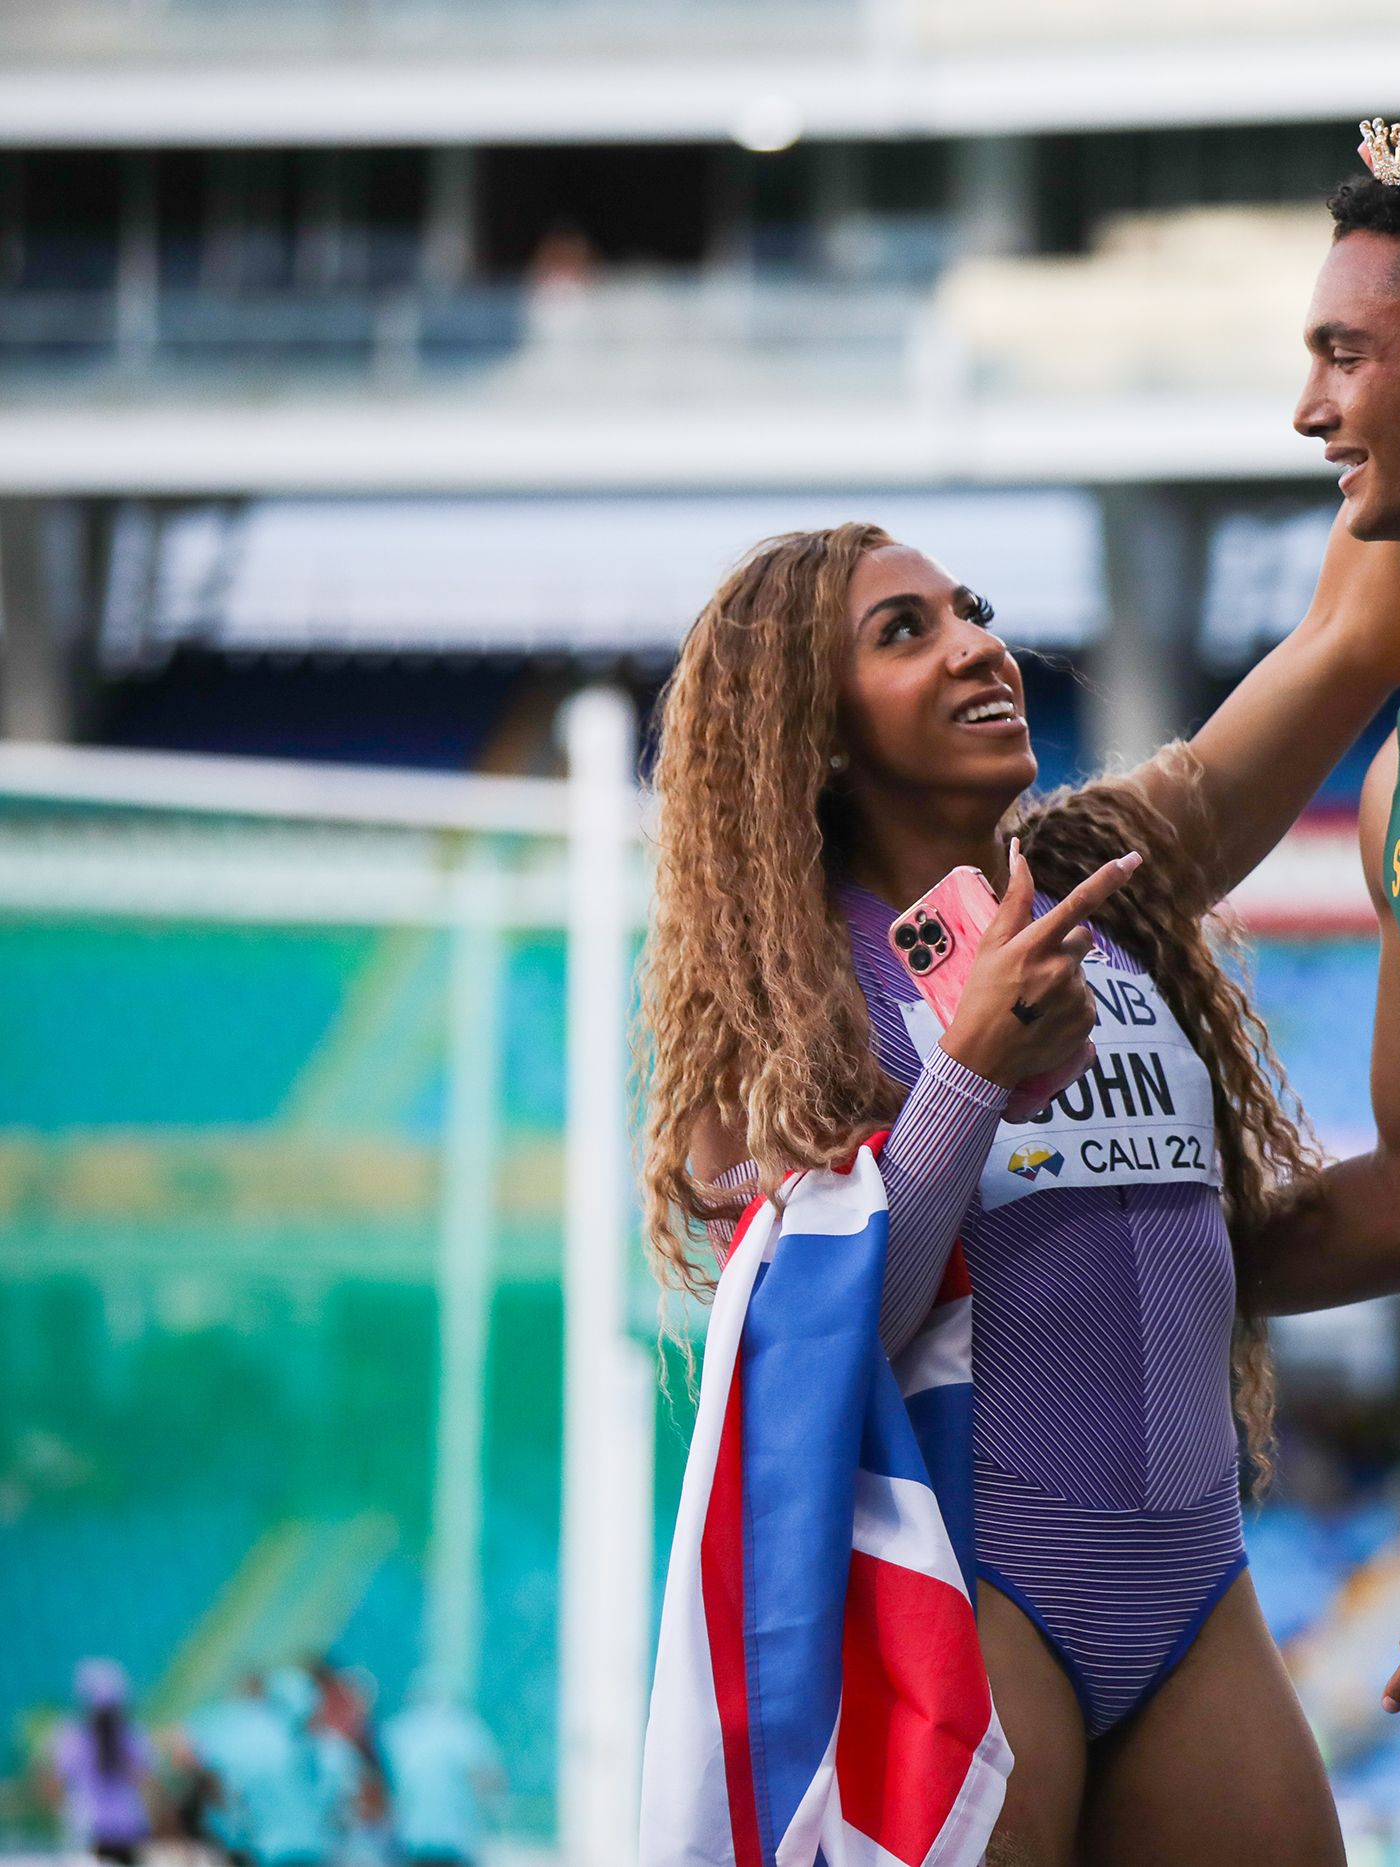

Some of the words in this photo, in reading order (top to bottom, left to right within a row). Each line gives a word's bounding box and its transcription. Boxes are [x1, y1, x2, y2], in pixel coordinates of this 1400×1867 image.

[1086, 978, 1157, 1026] NB
[1028, 1051, 1176, 1124] OHN
[1080, 1136, 1160, 1174] CALI
[1165, 1135, 1206, 1170] 22
